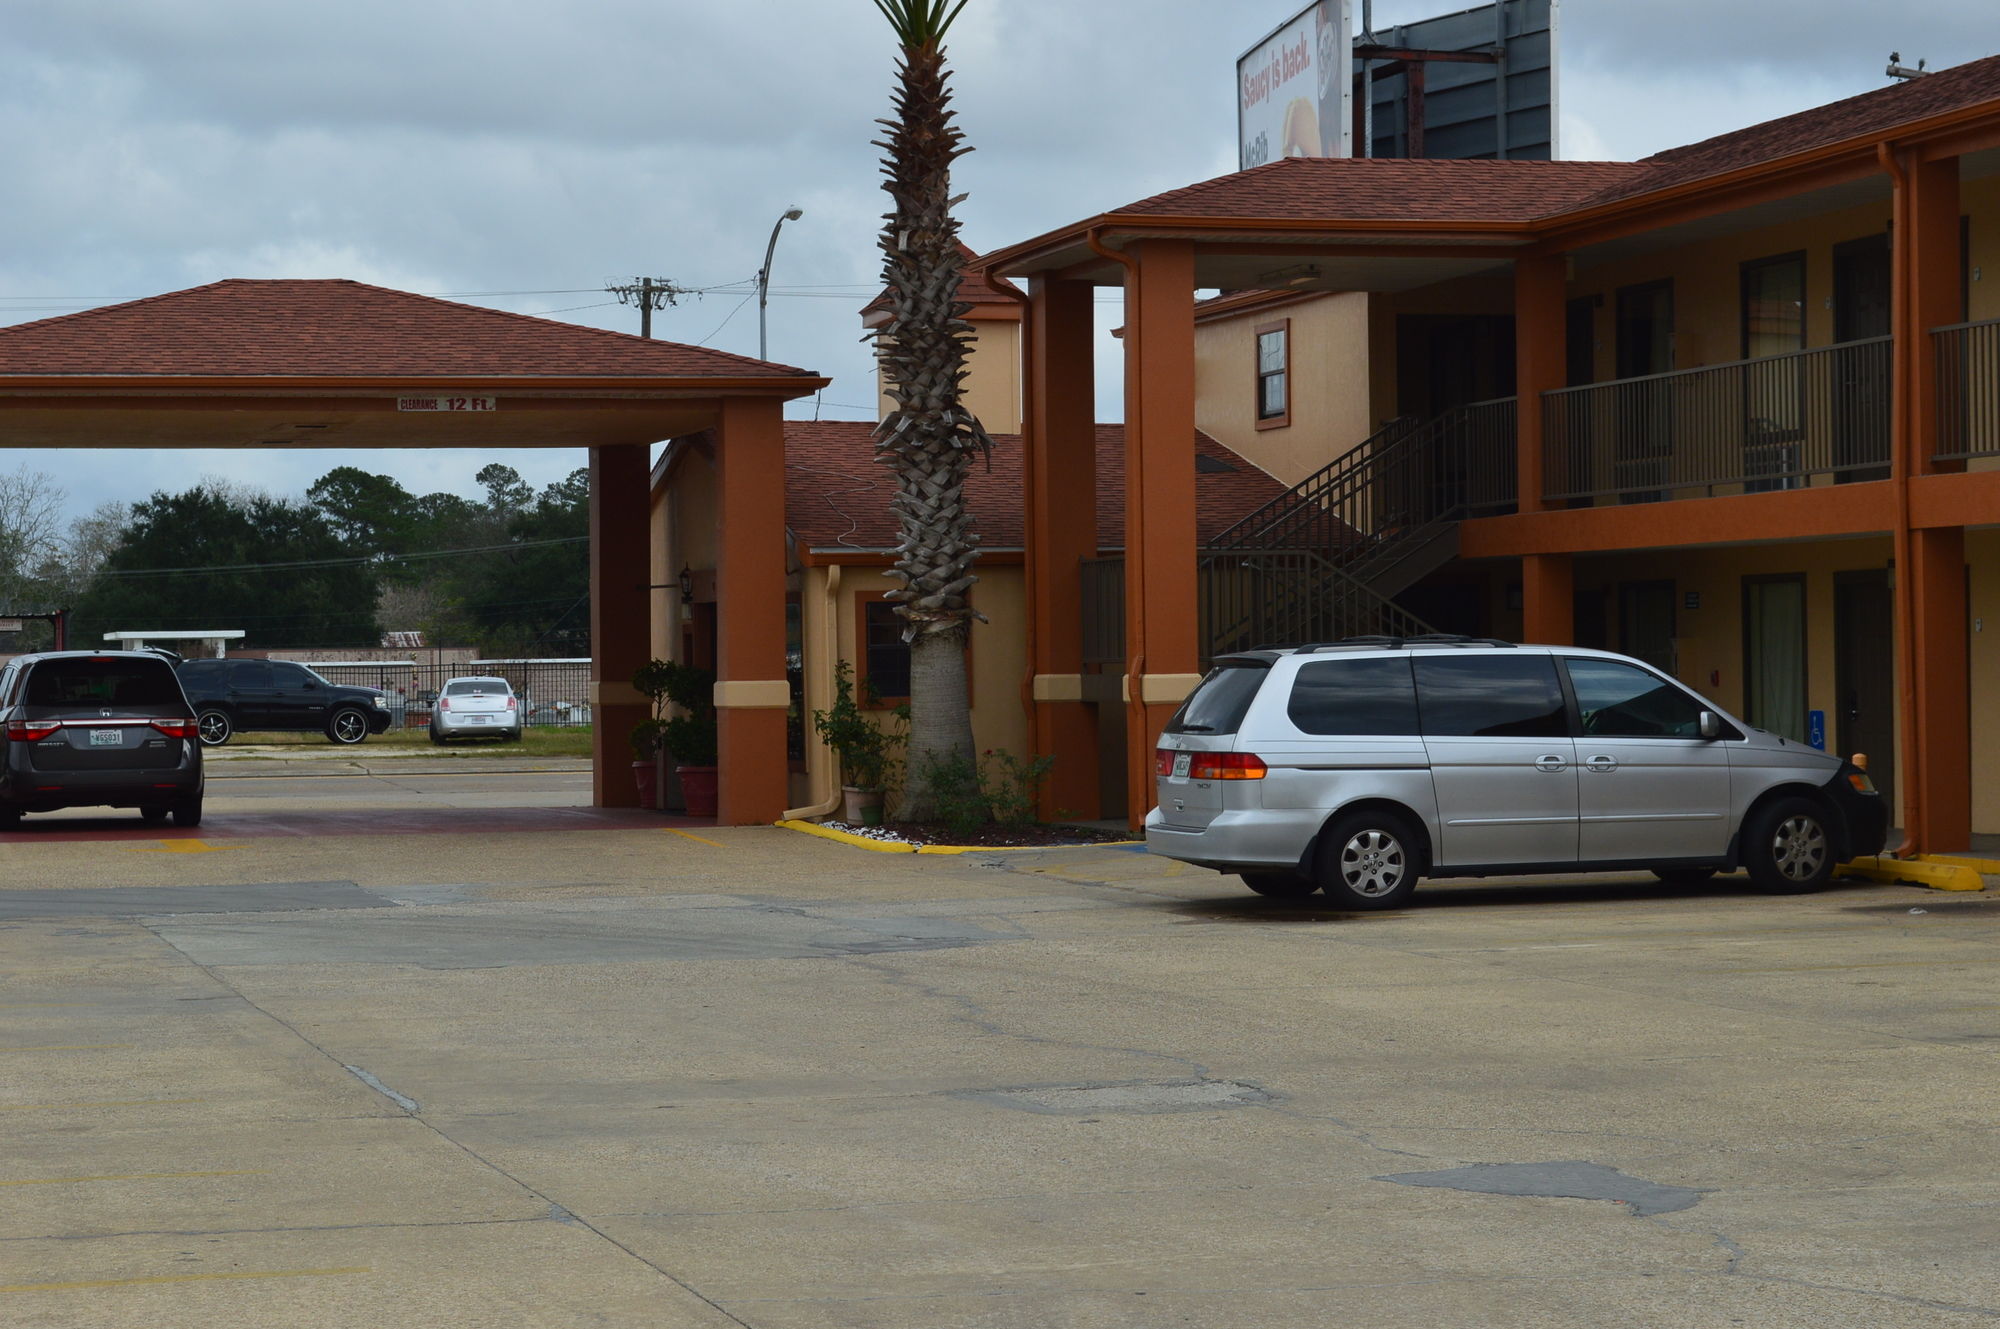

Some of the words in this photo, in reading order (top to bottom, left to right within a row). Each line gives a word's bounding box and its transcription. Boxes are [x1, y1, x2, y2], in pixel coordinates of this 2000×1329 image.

[1244, 64, 1271, 110] Saucy
[1272, 50, 1280, 91] is
[1282, 32, 1310, 83] back.
[1245, 130, 1269, 168] McRib
[401, 399, 438, 410] CLEARANCE
[446, 398, 467, 410] 12
